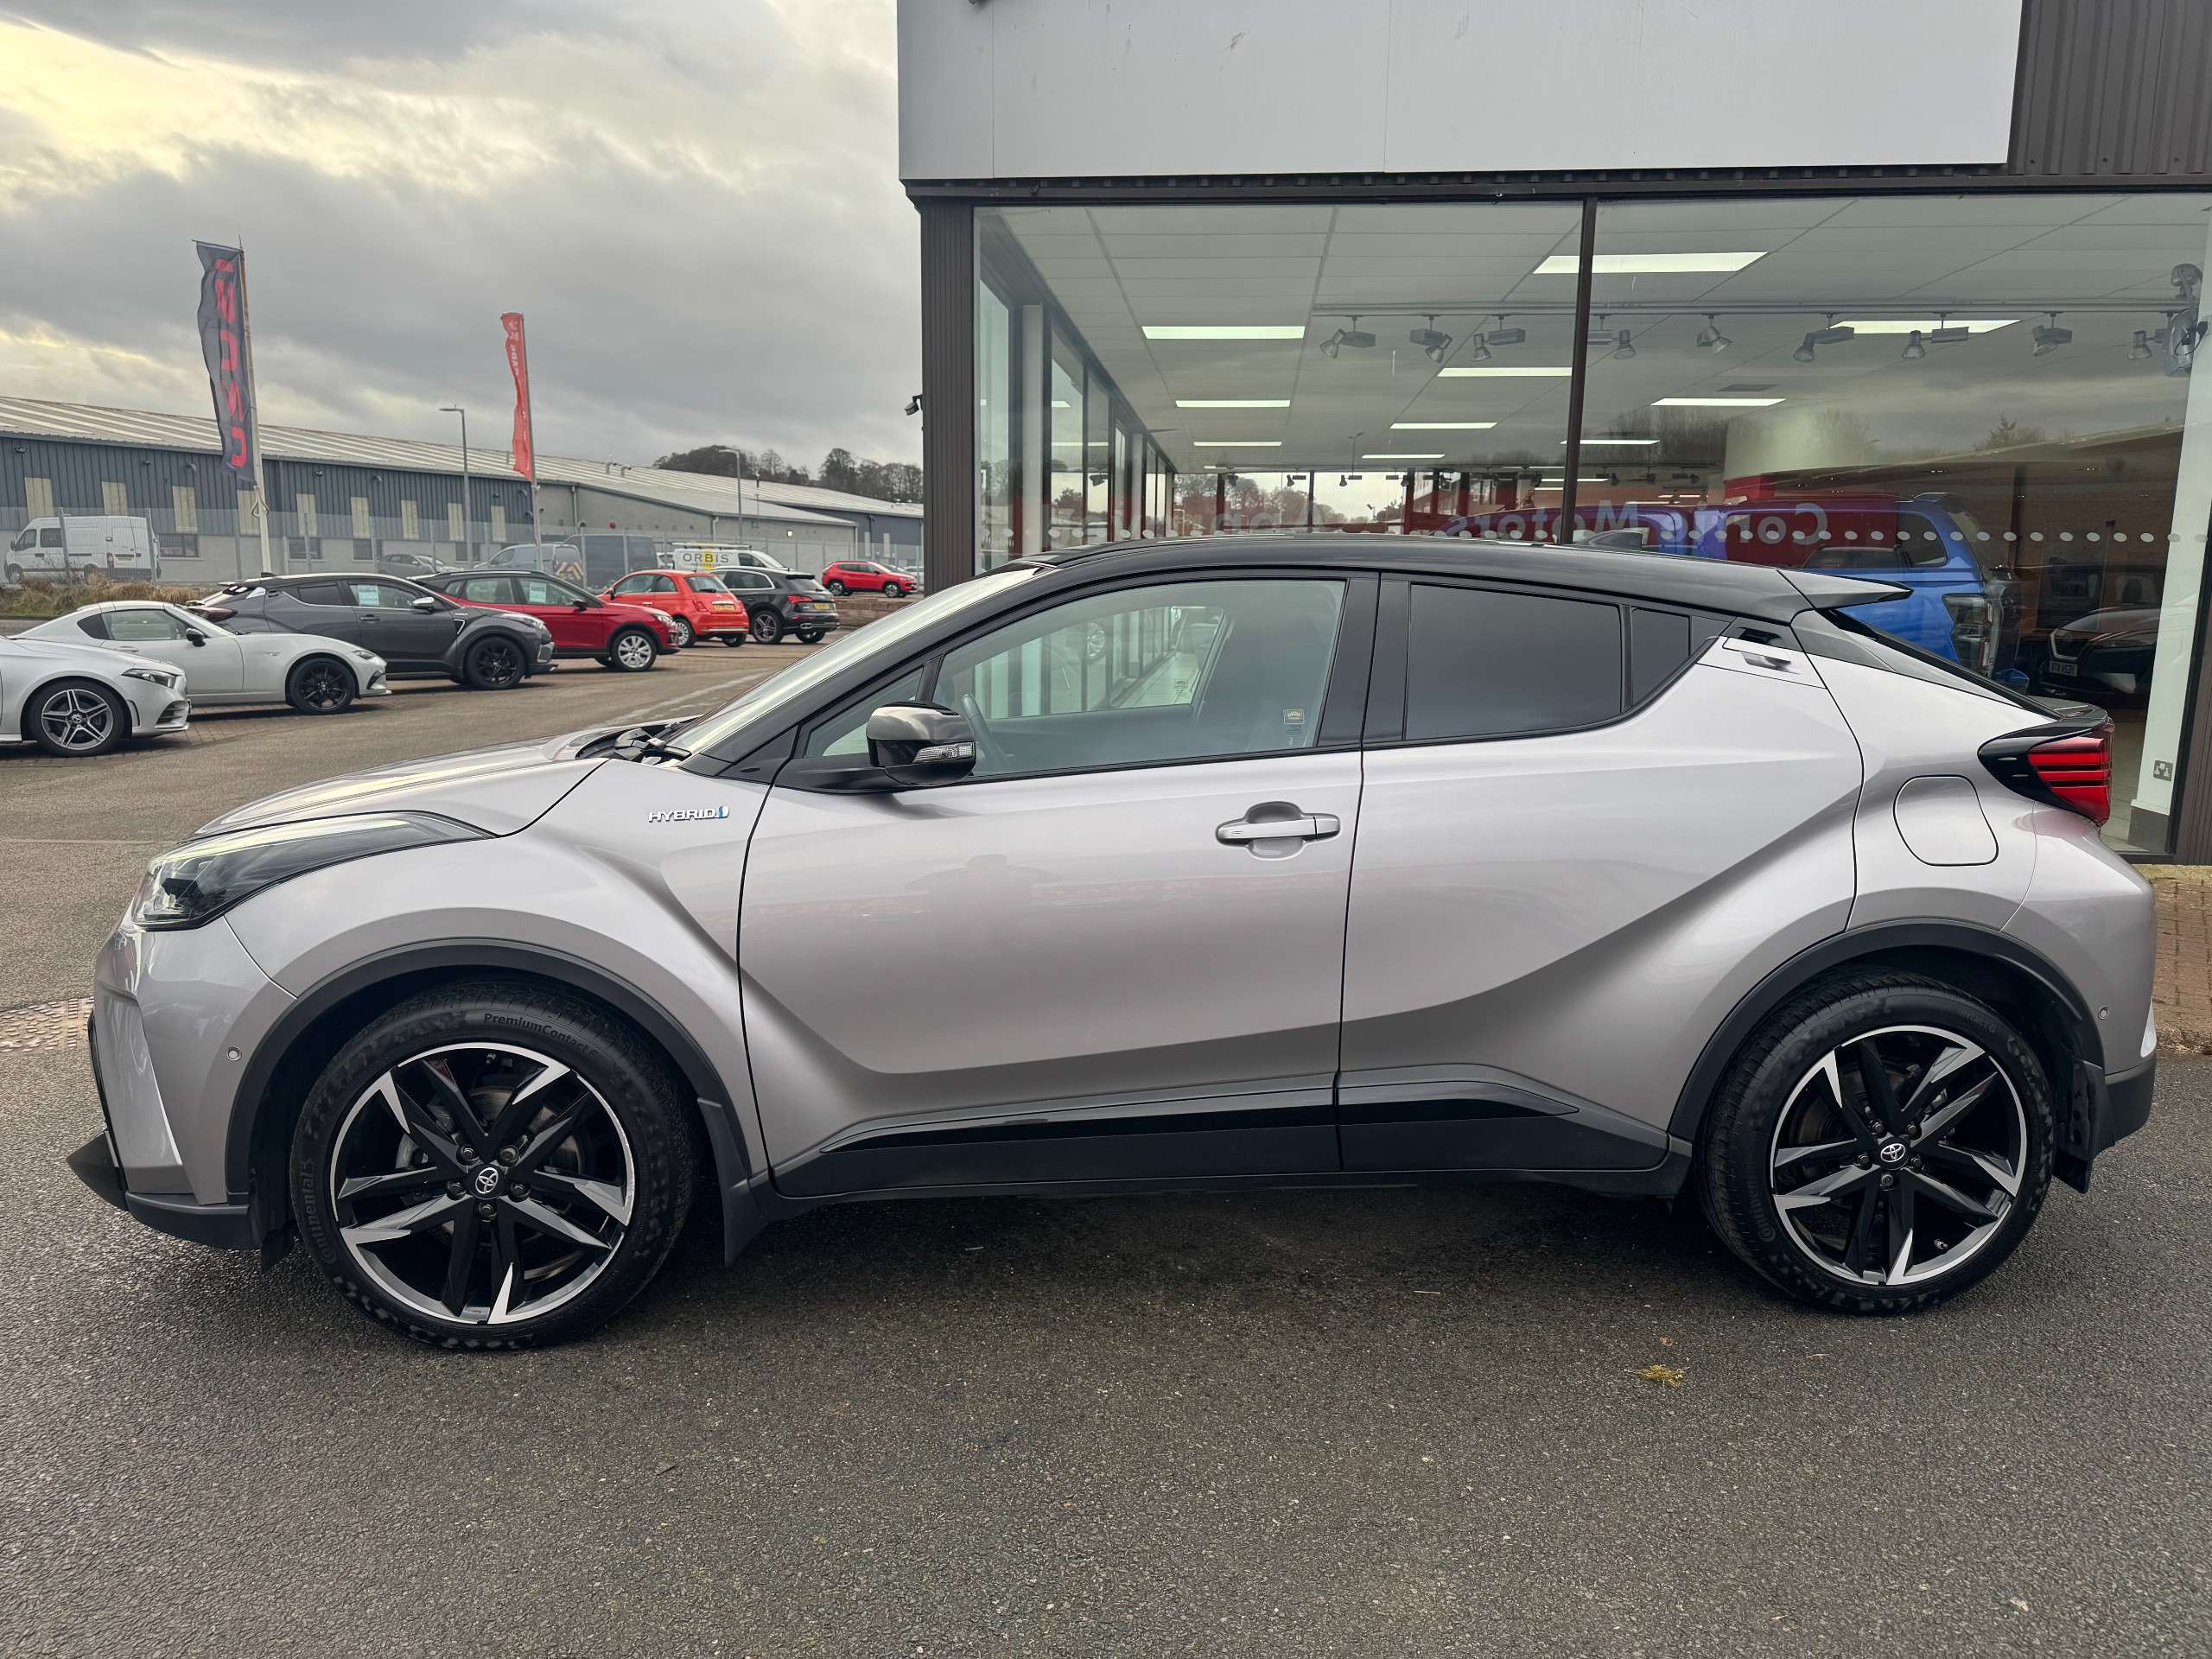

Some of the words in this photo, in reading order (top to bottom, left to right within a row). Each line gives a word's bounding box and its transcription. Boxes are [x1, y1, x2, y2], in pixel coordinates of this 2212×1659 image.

[683, 553, 729, 563] ORBIS
[648, 808, 716, 823] HYBRID
[484, 1013, 589, 1052] PremiumContact
[300, 1169, 338, 1264] Continental
